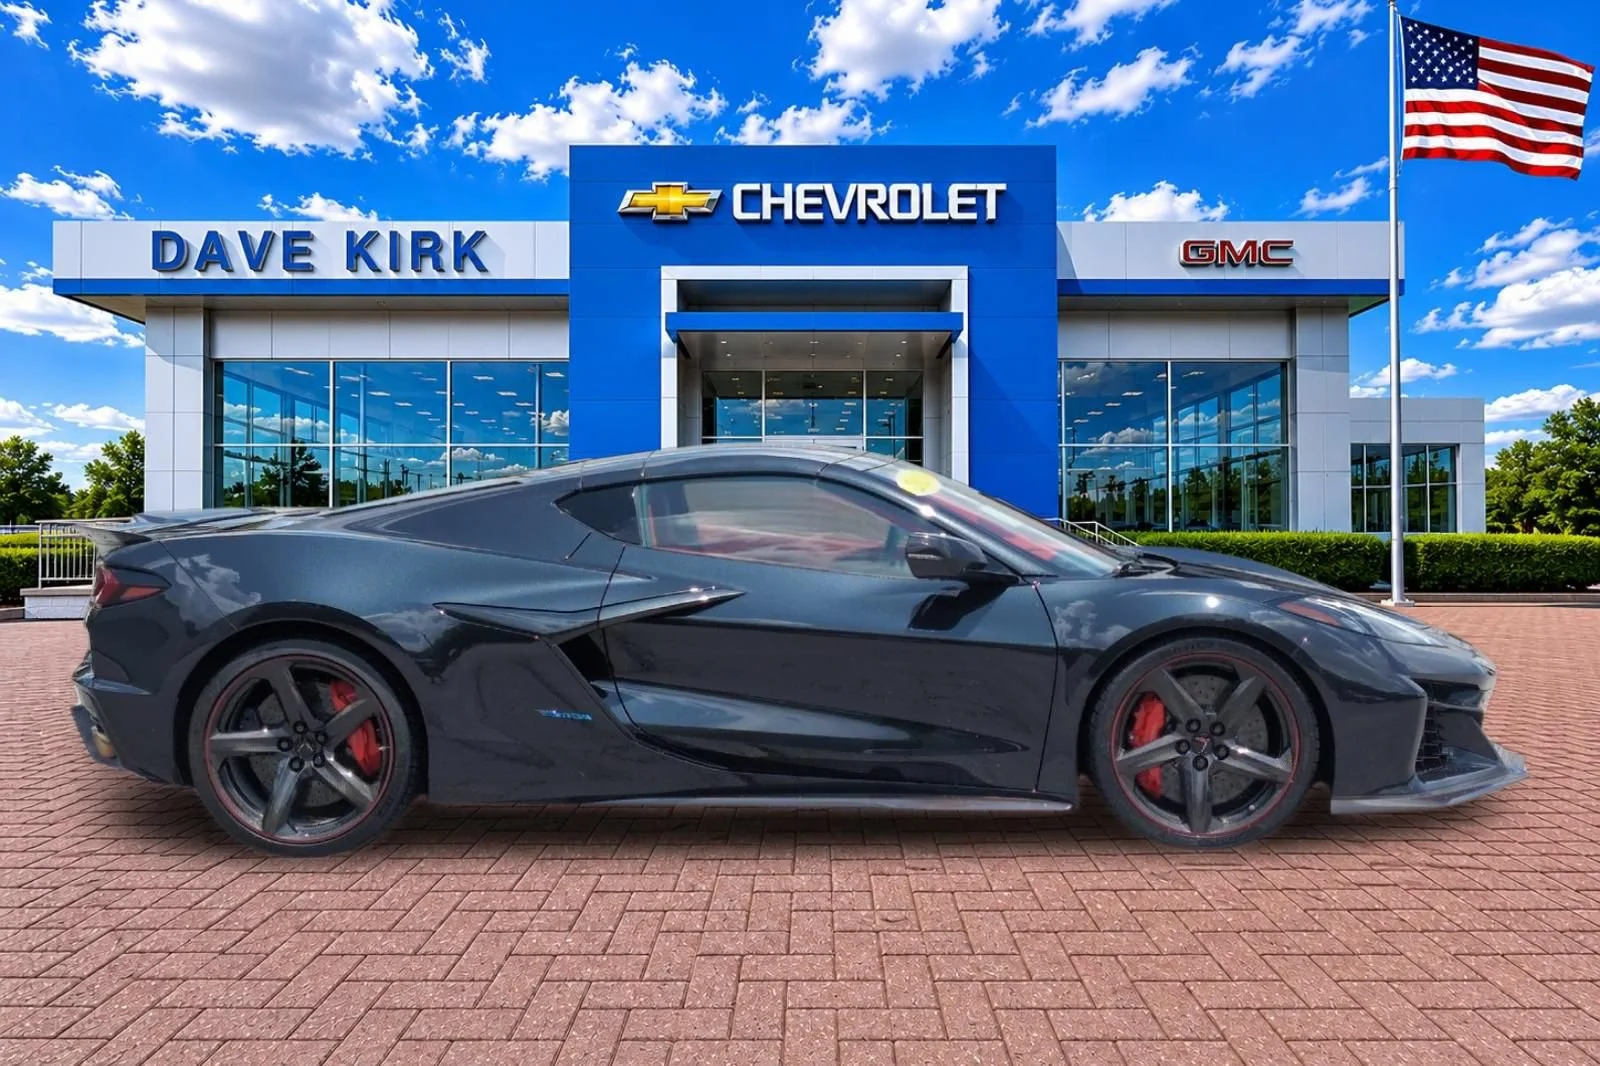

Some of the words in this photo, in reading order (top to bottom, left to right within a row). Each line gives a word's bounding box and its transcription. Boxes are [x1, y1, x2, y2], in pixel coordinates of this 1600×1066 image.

[732, 182, 1007, 221] CHEVROLET
[151, 230, 313, 272] DAVE
[346, 230, 489, 272] KIRK
[1179, 239, 1294, 265] GMC
